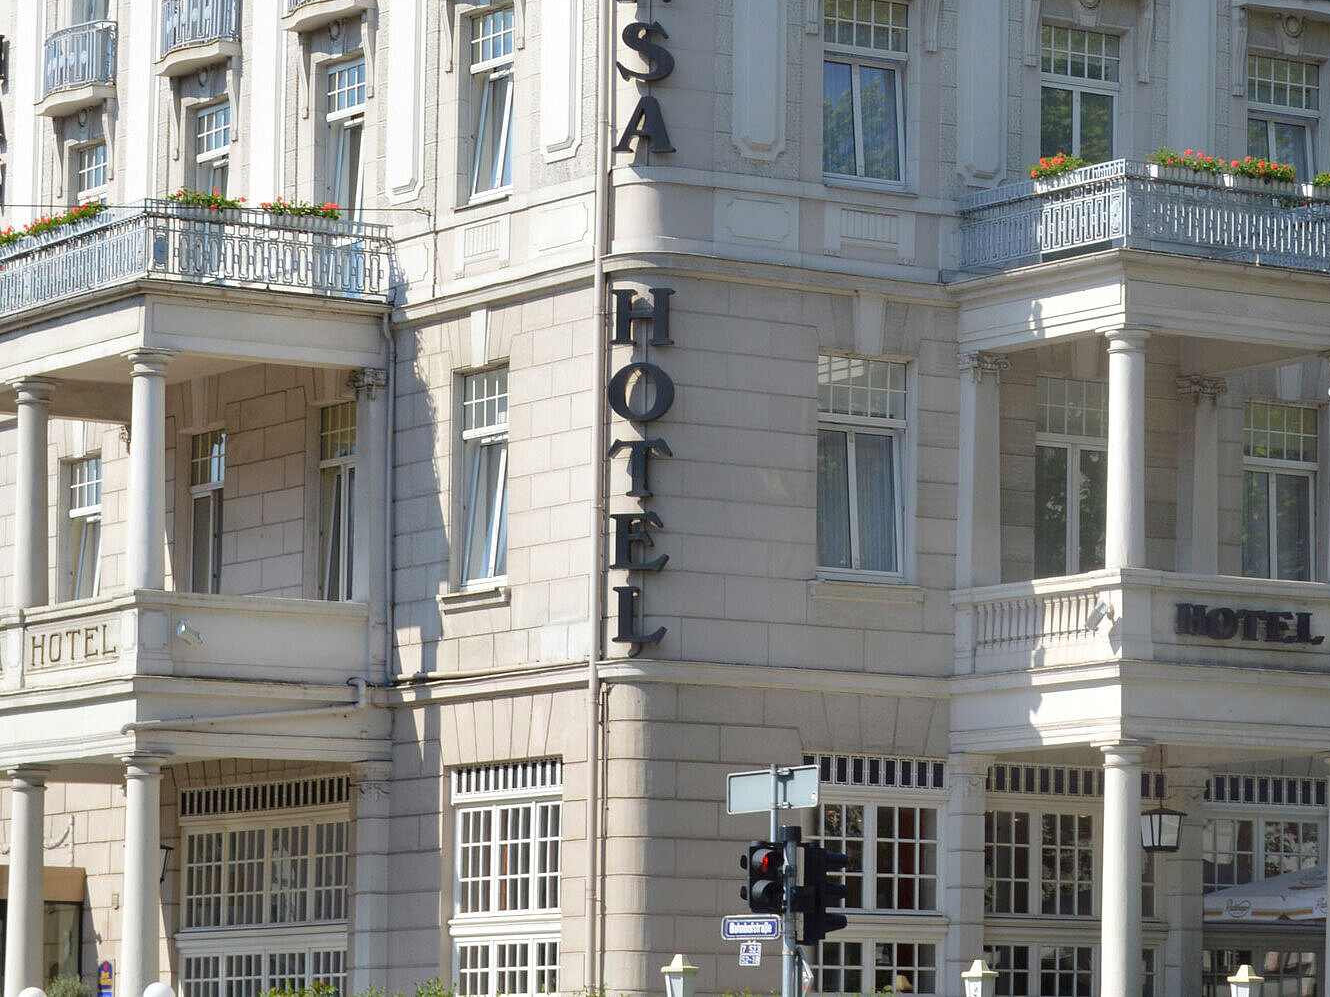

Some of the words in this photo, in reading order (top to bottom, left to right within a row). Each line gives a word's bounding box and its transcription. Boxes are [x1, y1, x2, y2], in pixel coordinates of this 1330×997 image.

[607, 287, 676, 645] HOTEL
[31, 624, 117, 667] HOTEL
[1175, 603, 1325, 645] HOTEL
